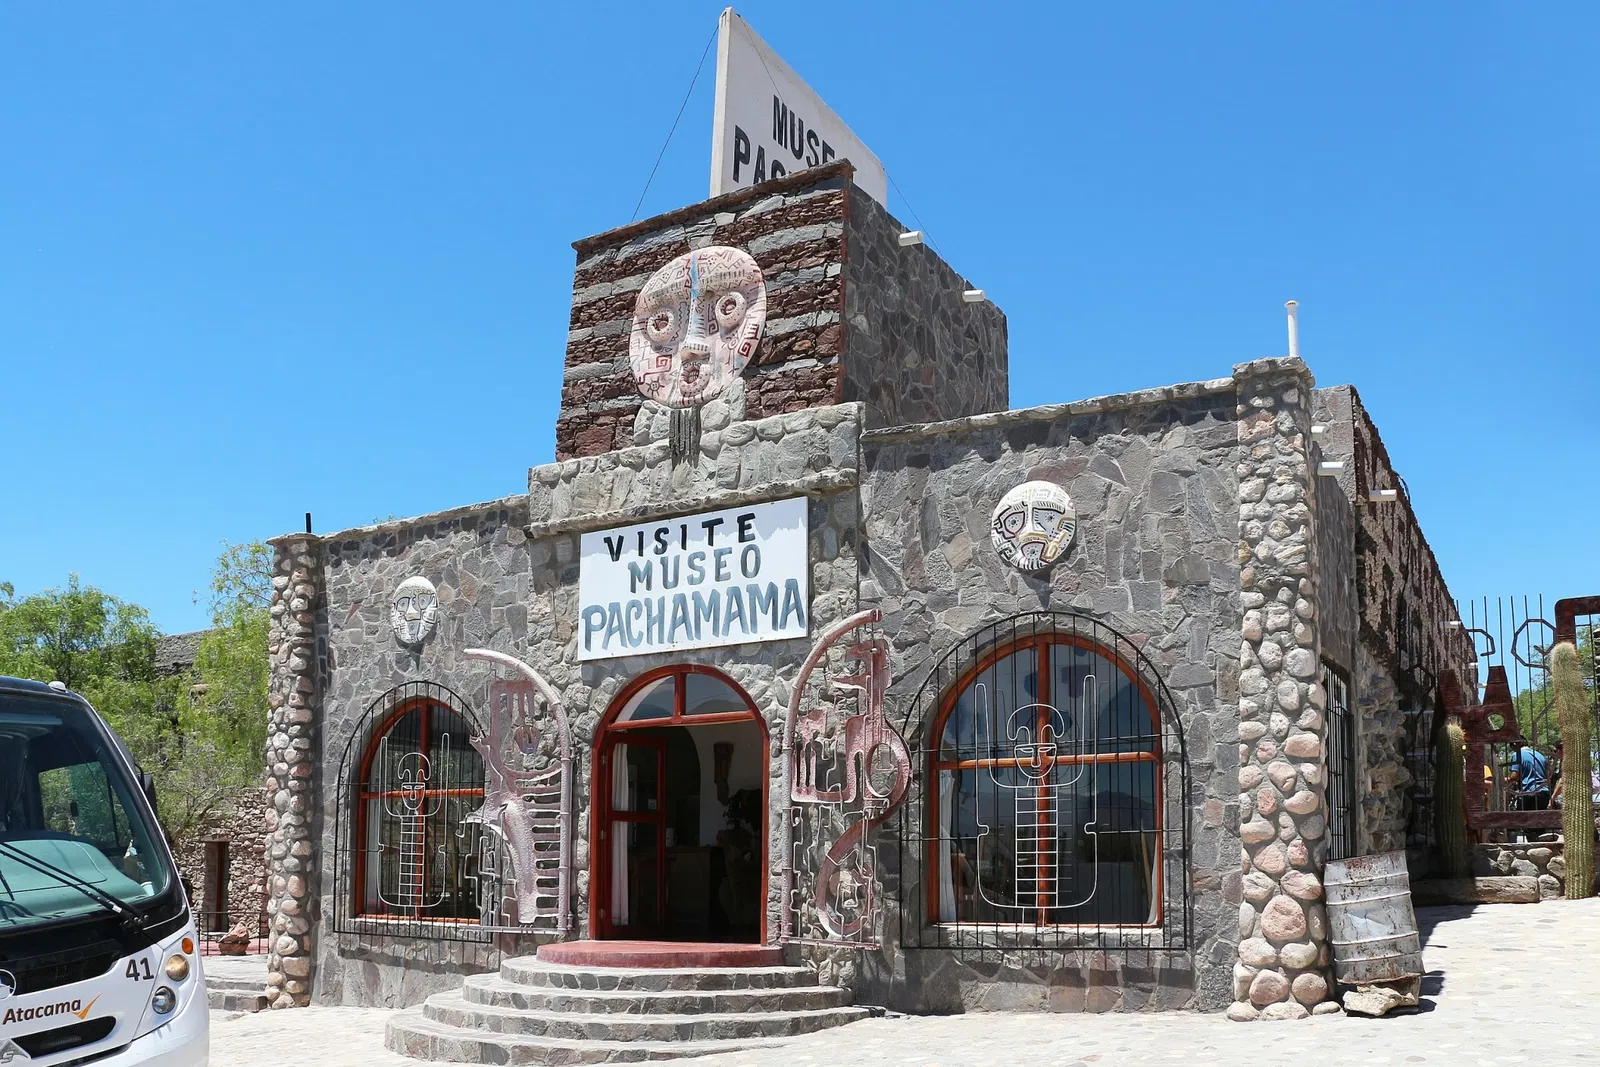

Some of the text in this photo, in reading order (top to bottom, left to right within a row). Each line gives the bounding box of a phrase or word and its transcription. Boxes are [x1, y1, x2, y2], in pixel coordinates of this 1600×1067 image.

[603, 512, 756, 562] VISITE
[627, 544, 761, 594] MUSEO
[581, 578, 806, 652] PACHAMAMA
[126, 957, 154, 981] 41
[2, 999, 81, 1025] Atacama
